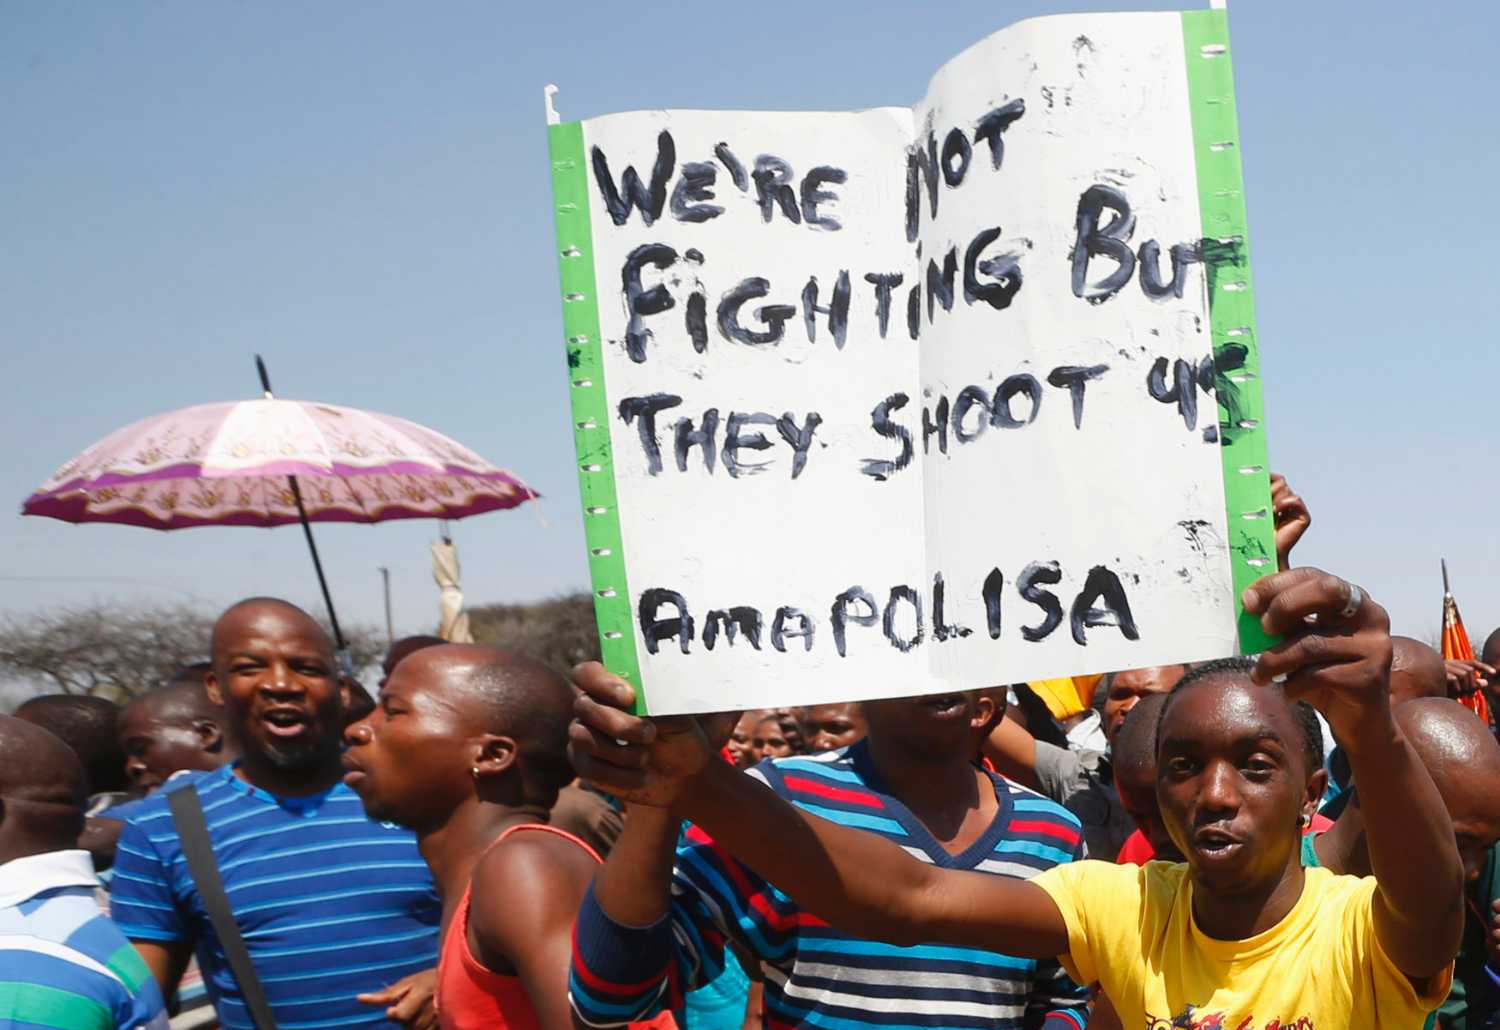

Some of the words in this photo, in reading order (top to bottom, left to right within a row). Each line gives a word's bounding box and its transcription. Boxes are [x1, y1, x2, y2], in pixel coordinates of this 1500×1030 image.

[904, 97, 1026, 243] NOT
[618, 391, 823, 480] THEY
[858, 363, 1110, 482] SHOOT
